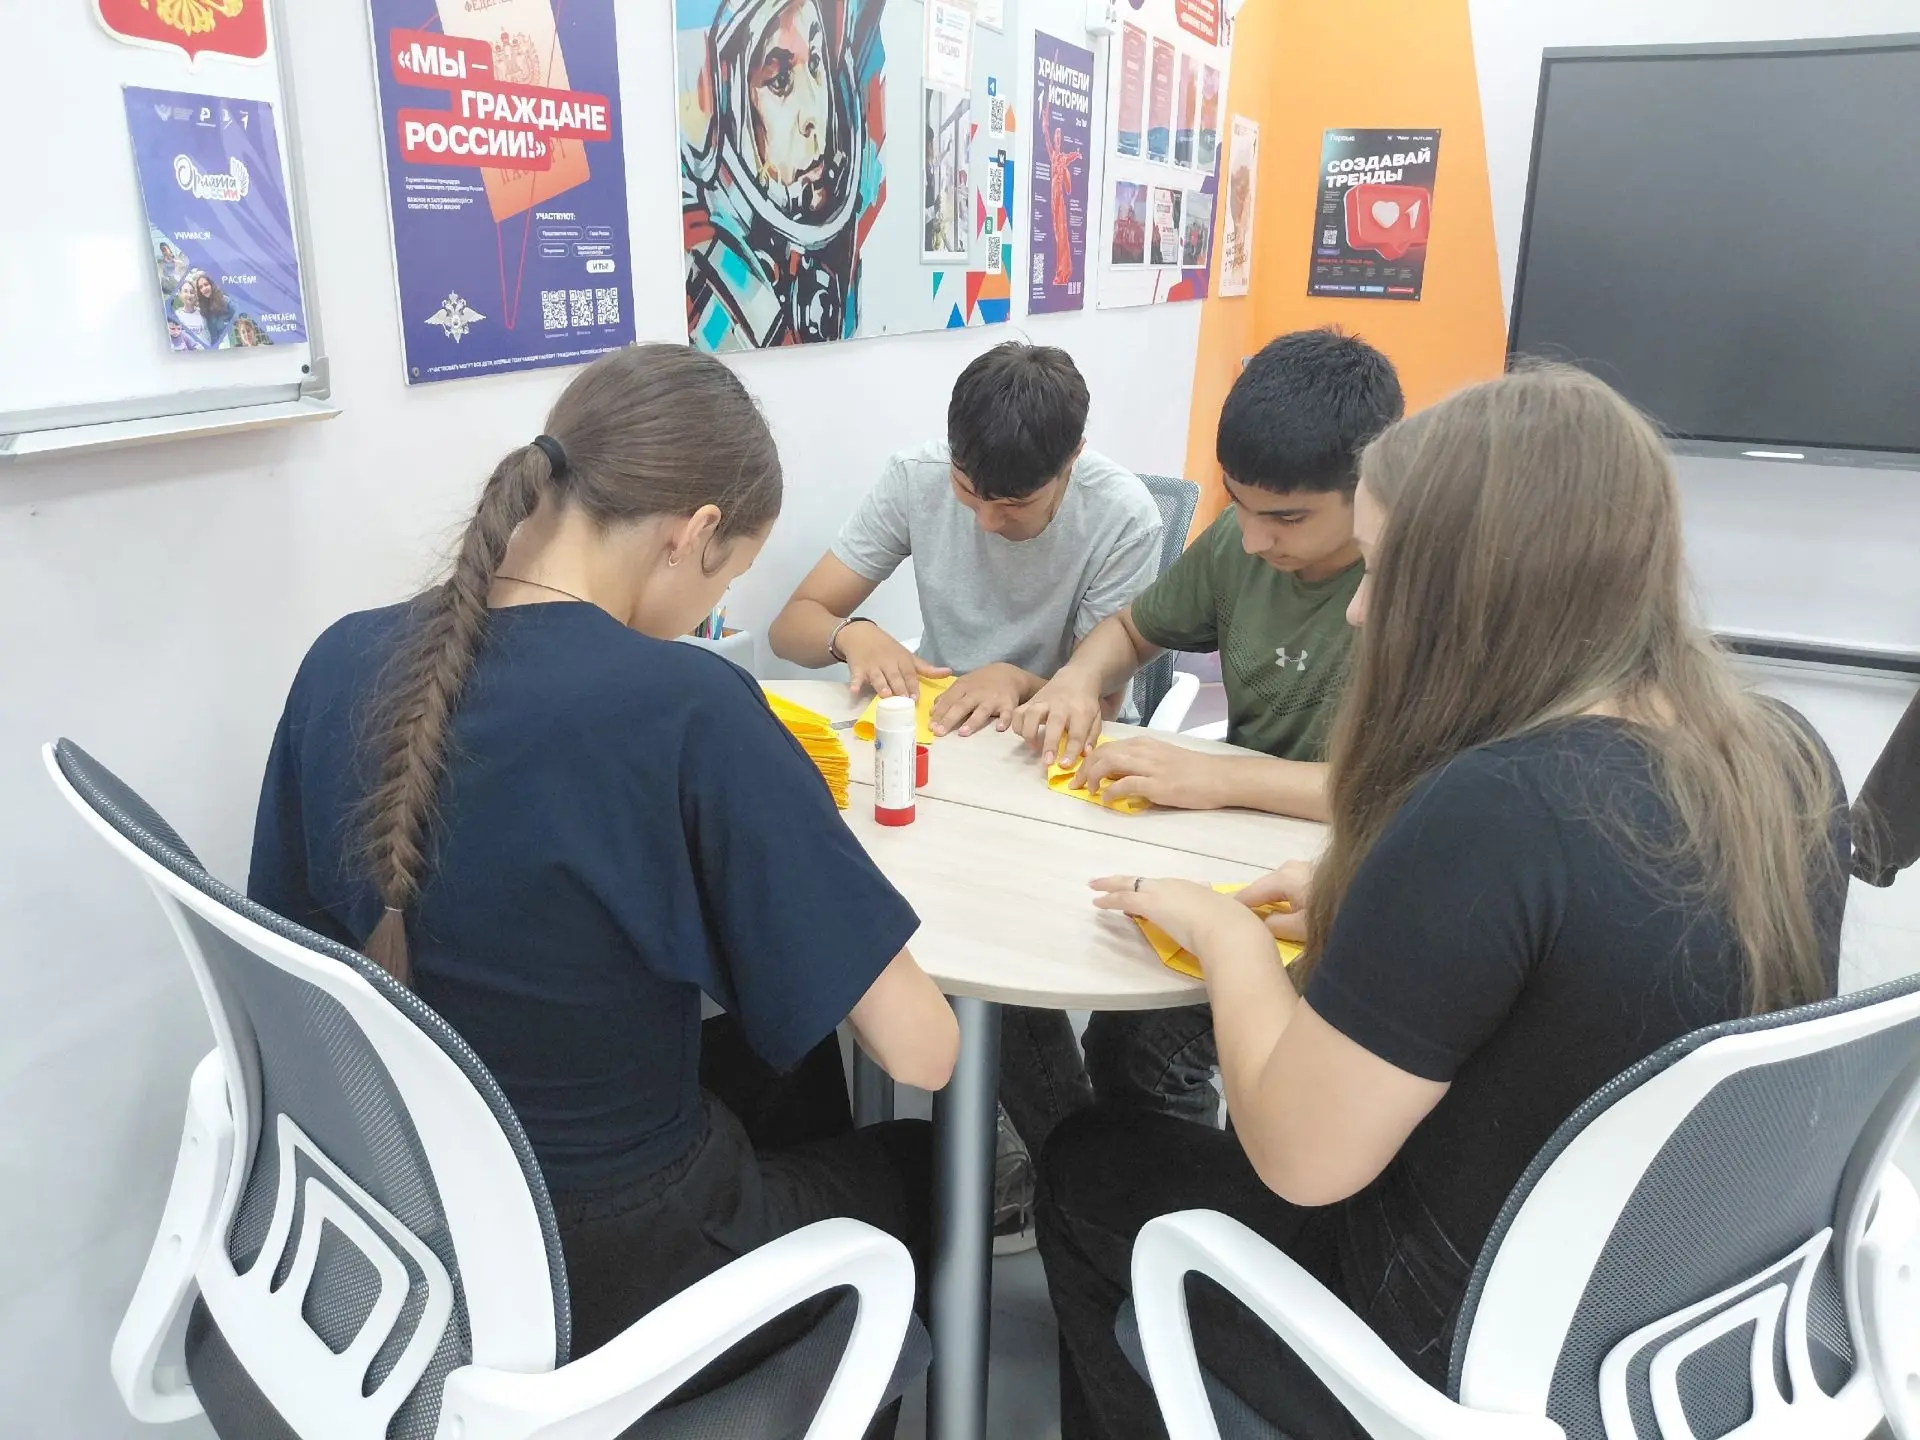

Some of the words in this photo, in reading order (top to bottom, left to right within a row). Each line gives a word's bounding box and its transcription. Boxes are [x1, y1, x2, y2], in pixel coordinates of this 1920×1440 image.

[397, 43, 467, 79] «МЫ
[1038, 57, 1090, 92] ХРАНИТЕЛИ
[461, 89, 607, 131] ГРАЖДАНЕ
[1048, 84, 1089, 114] ИСТОРИИ
[405, 121, 546, 159] РОССИИ!»
[1327, 147, 1431, 173] СОЗДАВАЙ
[1326, 169, 1403, 188] ТРЕНДЫ
